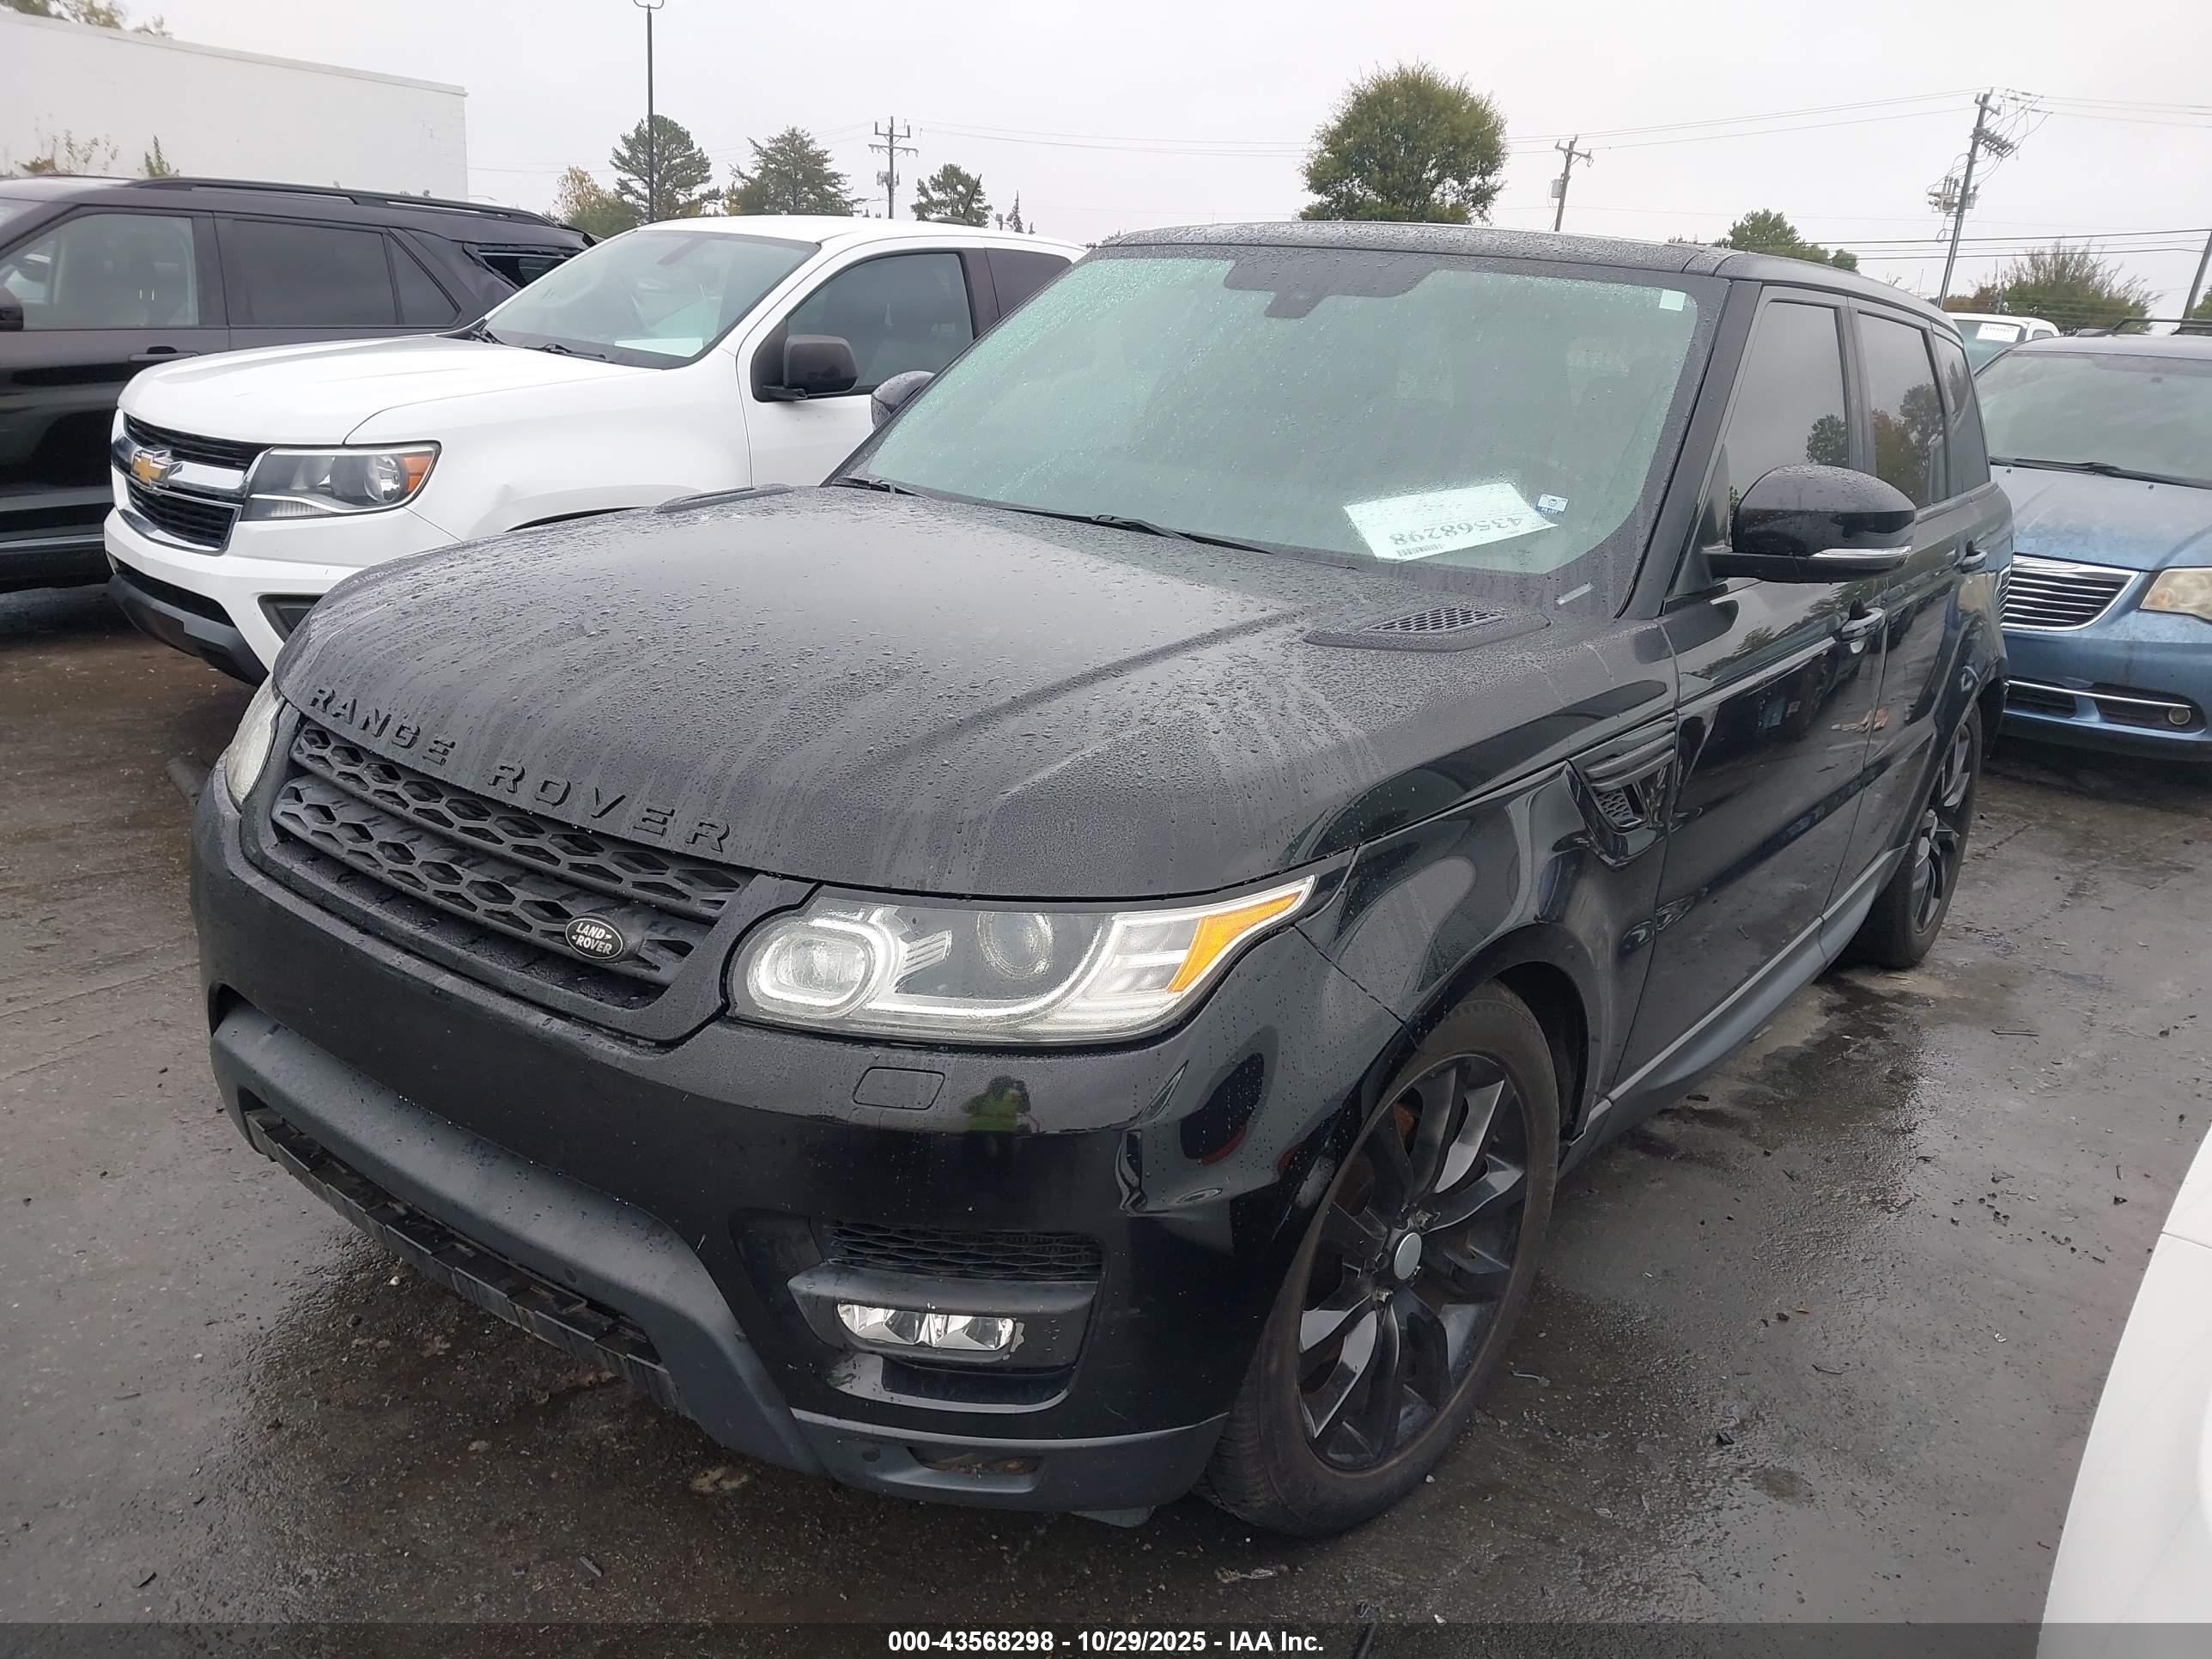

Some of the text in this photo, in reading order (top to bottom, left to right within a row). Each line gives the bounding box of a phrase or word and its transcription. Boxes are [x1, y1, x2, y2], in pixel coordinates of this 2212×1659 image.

[1389, 517, 1522, 545] 43568298
[308, 684, 731, 853] RANGE ROVER
[575, 922, 606, 939] LAND
[575, 934, 613, 955] ROVER
